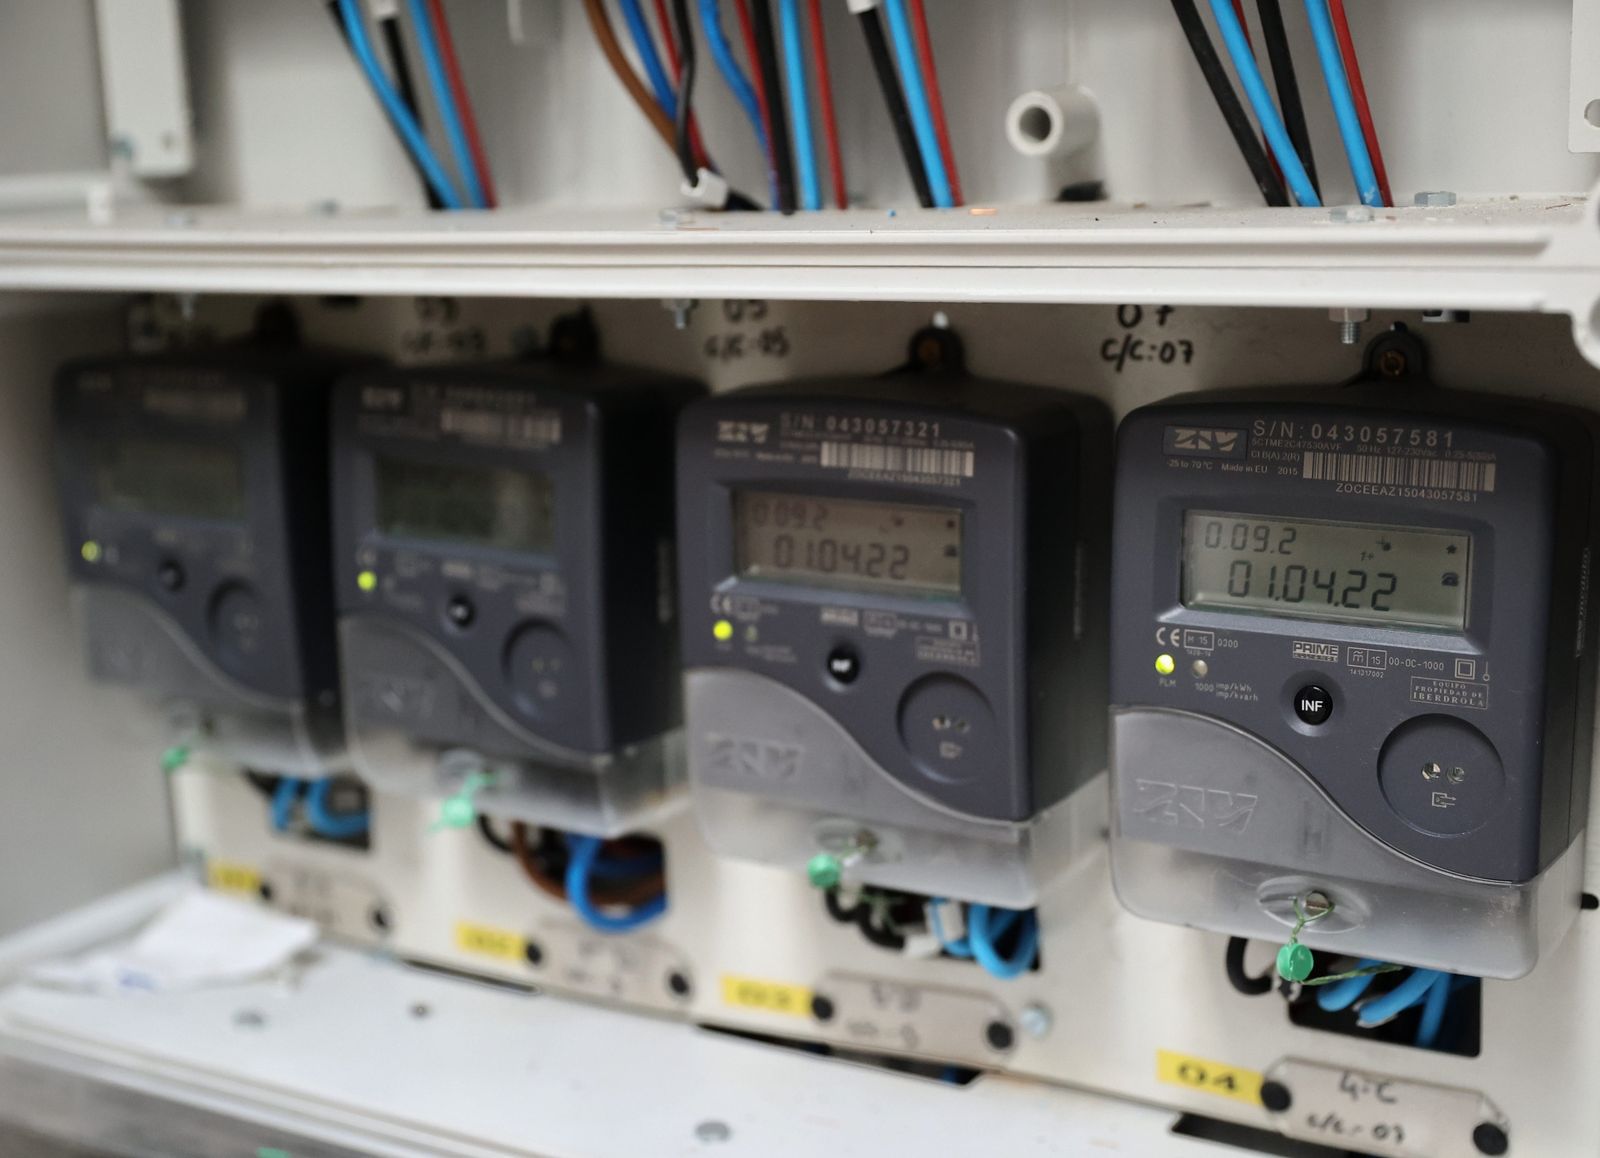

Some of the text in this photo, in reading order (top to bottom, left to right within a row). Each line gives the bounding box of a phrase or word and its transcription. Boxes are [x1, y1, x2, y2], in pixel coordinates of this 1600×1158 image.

[1311, 423, 1453, 447] 043057581
[1255, 465, 1268, 474] EU
[1227, 560, 1397, 611] 01.04.22
[1294, 642, 1338, 656] PRIME
[1301, 699, 1324, 712] INF
[1413, 691, 1485, 707] IBERDROLA
